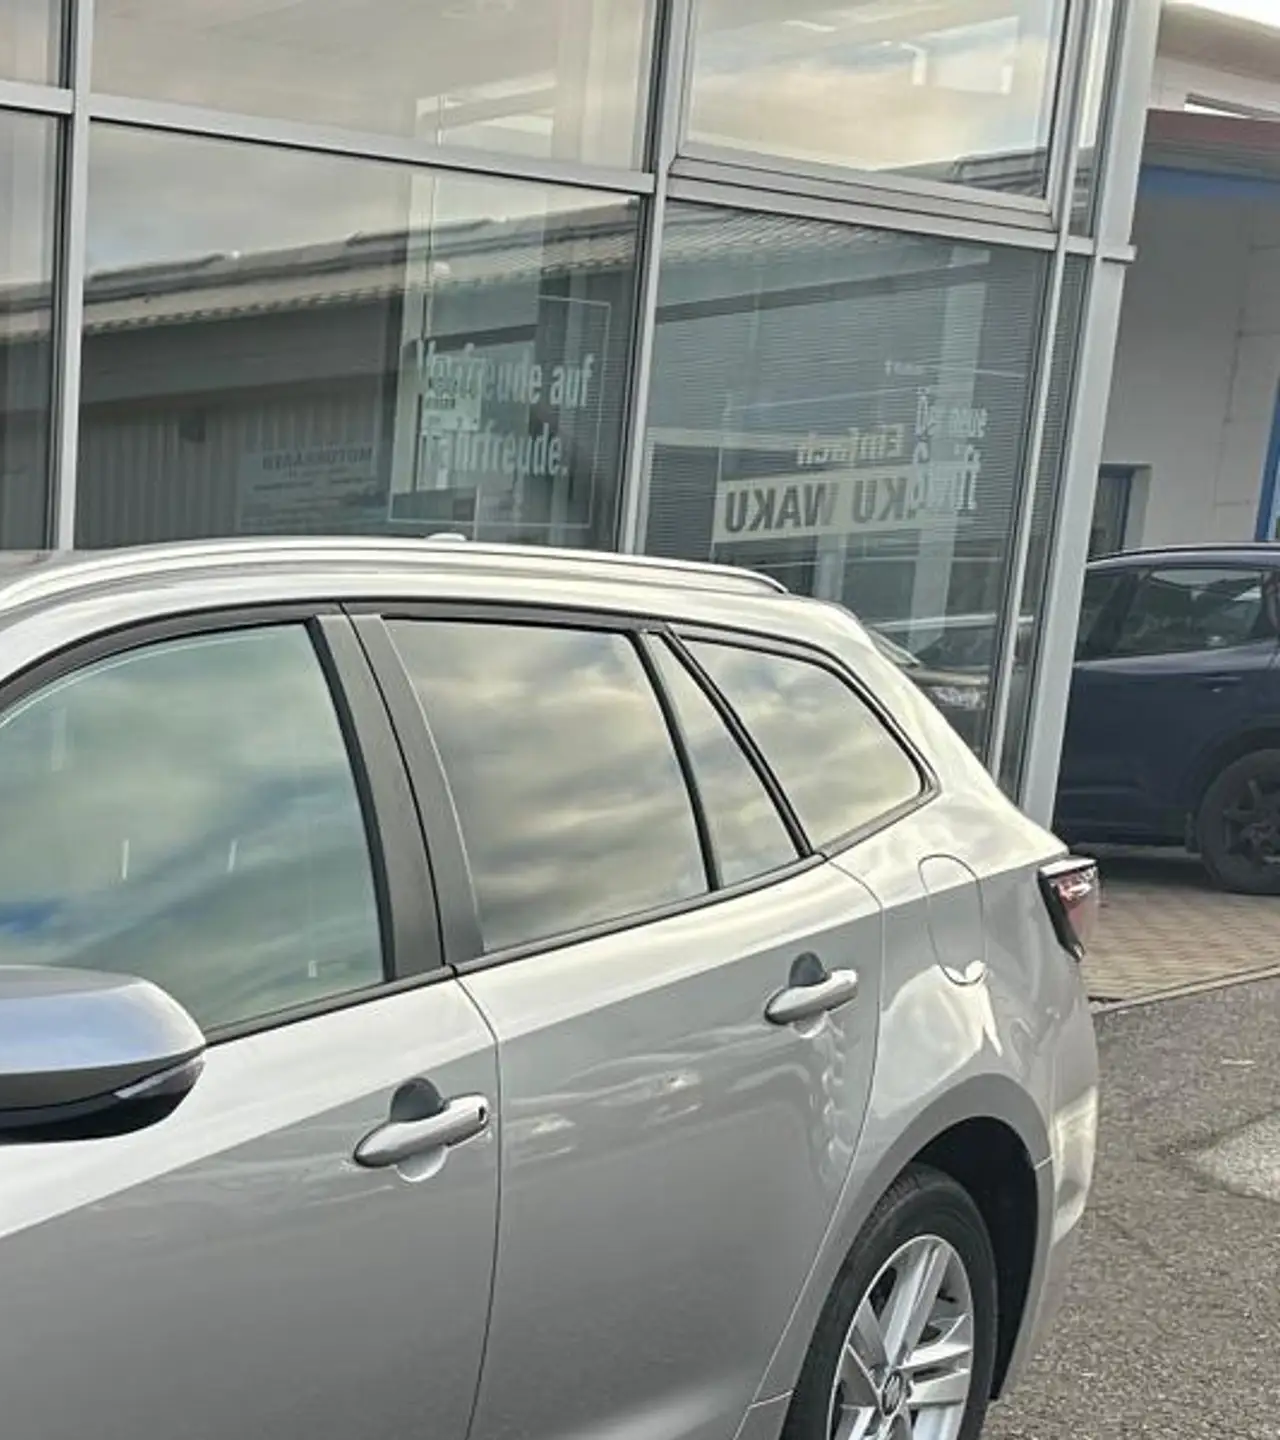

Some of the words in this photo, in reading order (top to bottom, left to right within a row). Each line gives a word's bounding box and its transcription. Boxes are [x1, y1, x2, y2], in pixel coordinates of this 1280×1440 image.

[416, 340, 543, 406] Vorfreude
[550, 352, 595, 410] auf
[419, 424, 569, 477] Fahrfreude.
